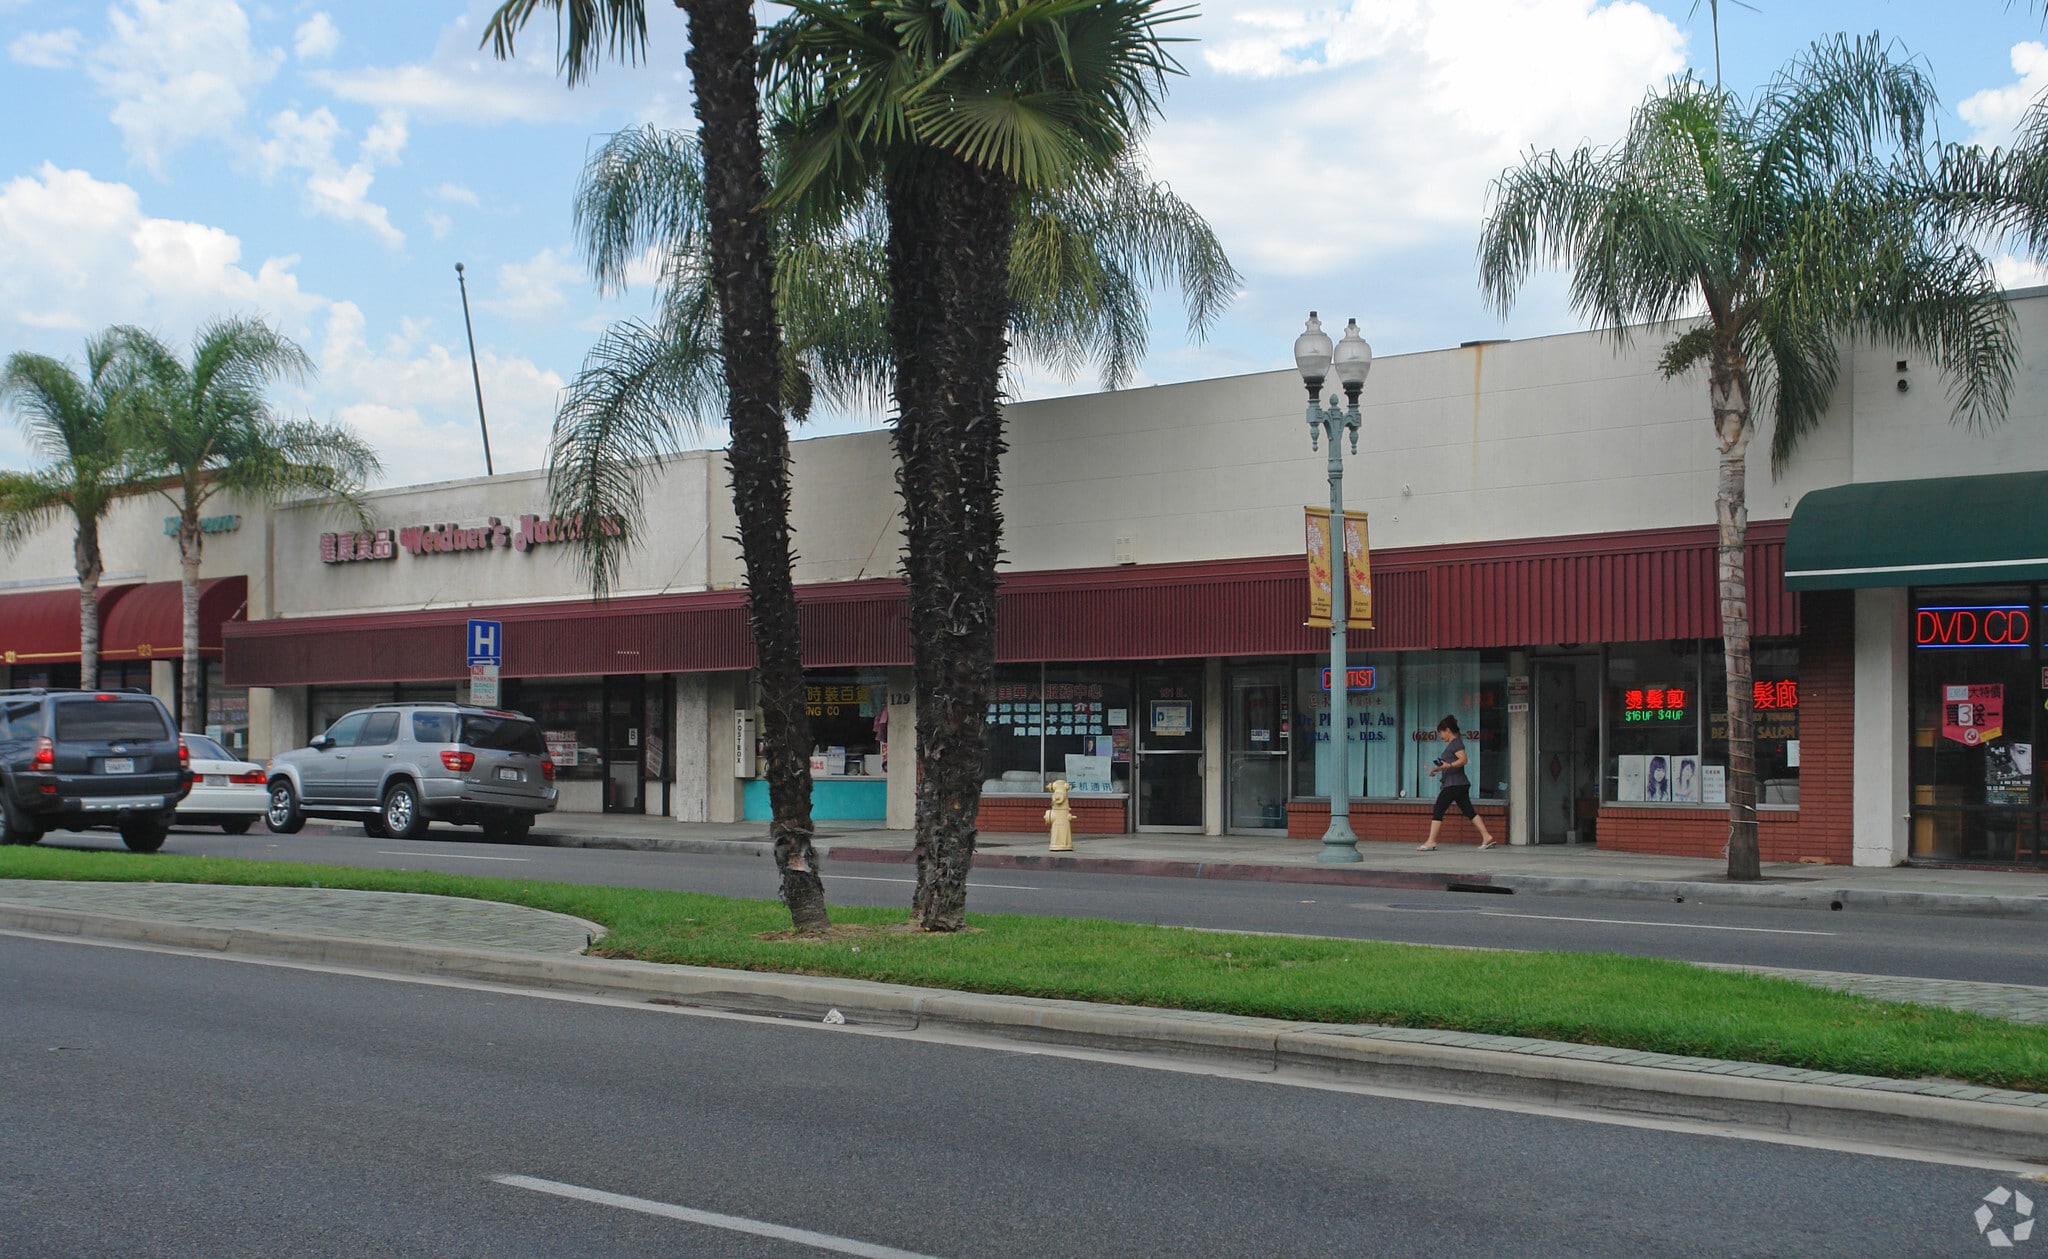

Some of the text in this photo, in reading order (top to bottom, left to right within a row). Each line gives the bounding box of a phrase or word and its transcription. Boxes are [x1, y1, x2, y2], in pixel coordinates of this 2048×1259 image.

[400, 516, 507, 554] Weidner's
[320, 529, 394, 562] 健康食品
[1917, 610, 2029, 643] DVD CD
[475, 625, 494, 655] H
[473, 666, 483, 674] NO
[1324, 670, 1373, 688] DTIST
[890, 693, 911, 705] 129
[1360, 712, 1373, 726] W.
[1378, 712, 1394, 726] Au
[1412, 731, 1438, 742] (626)
[1757, 726, 1796, 739] SALON
